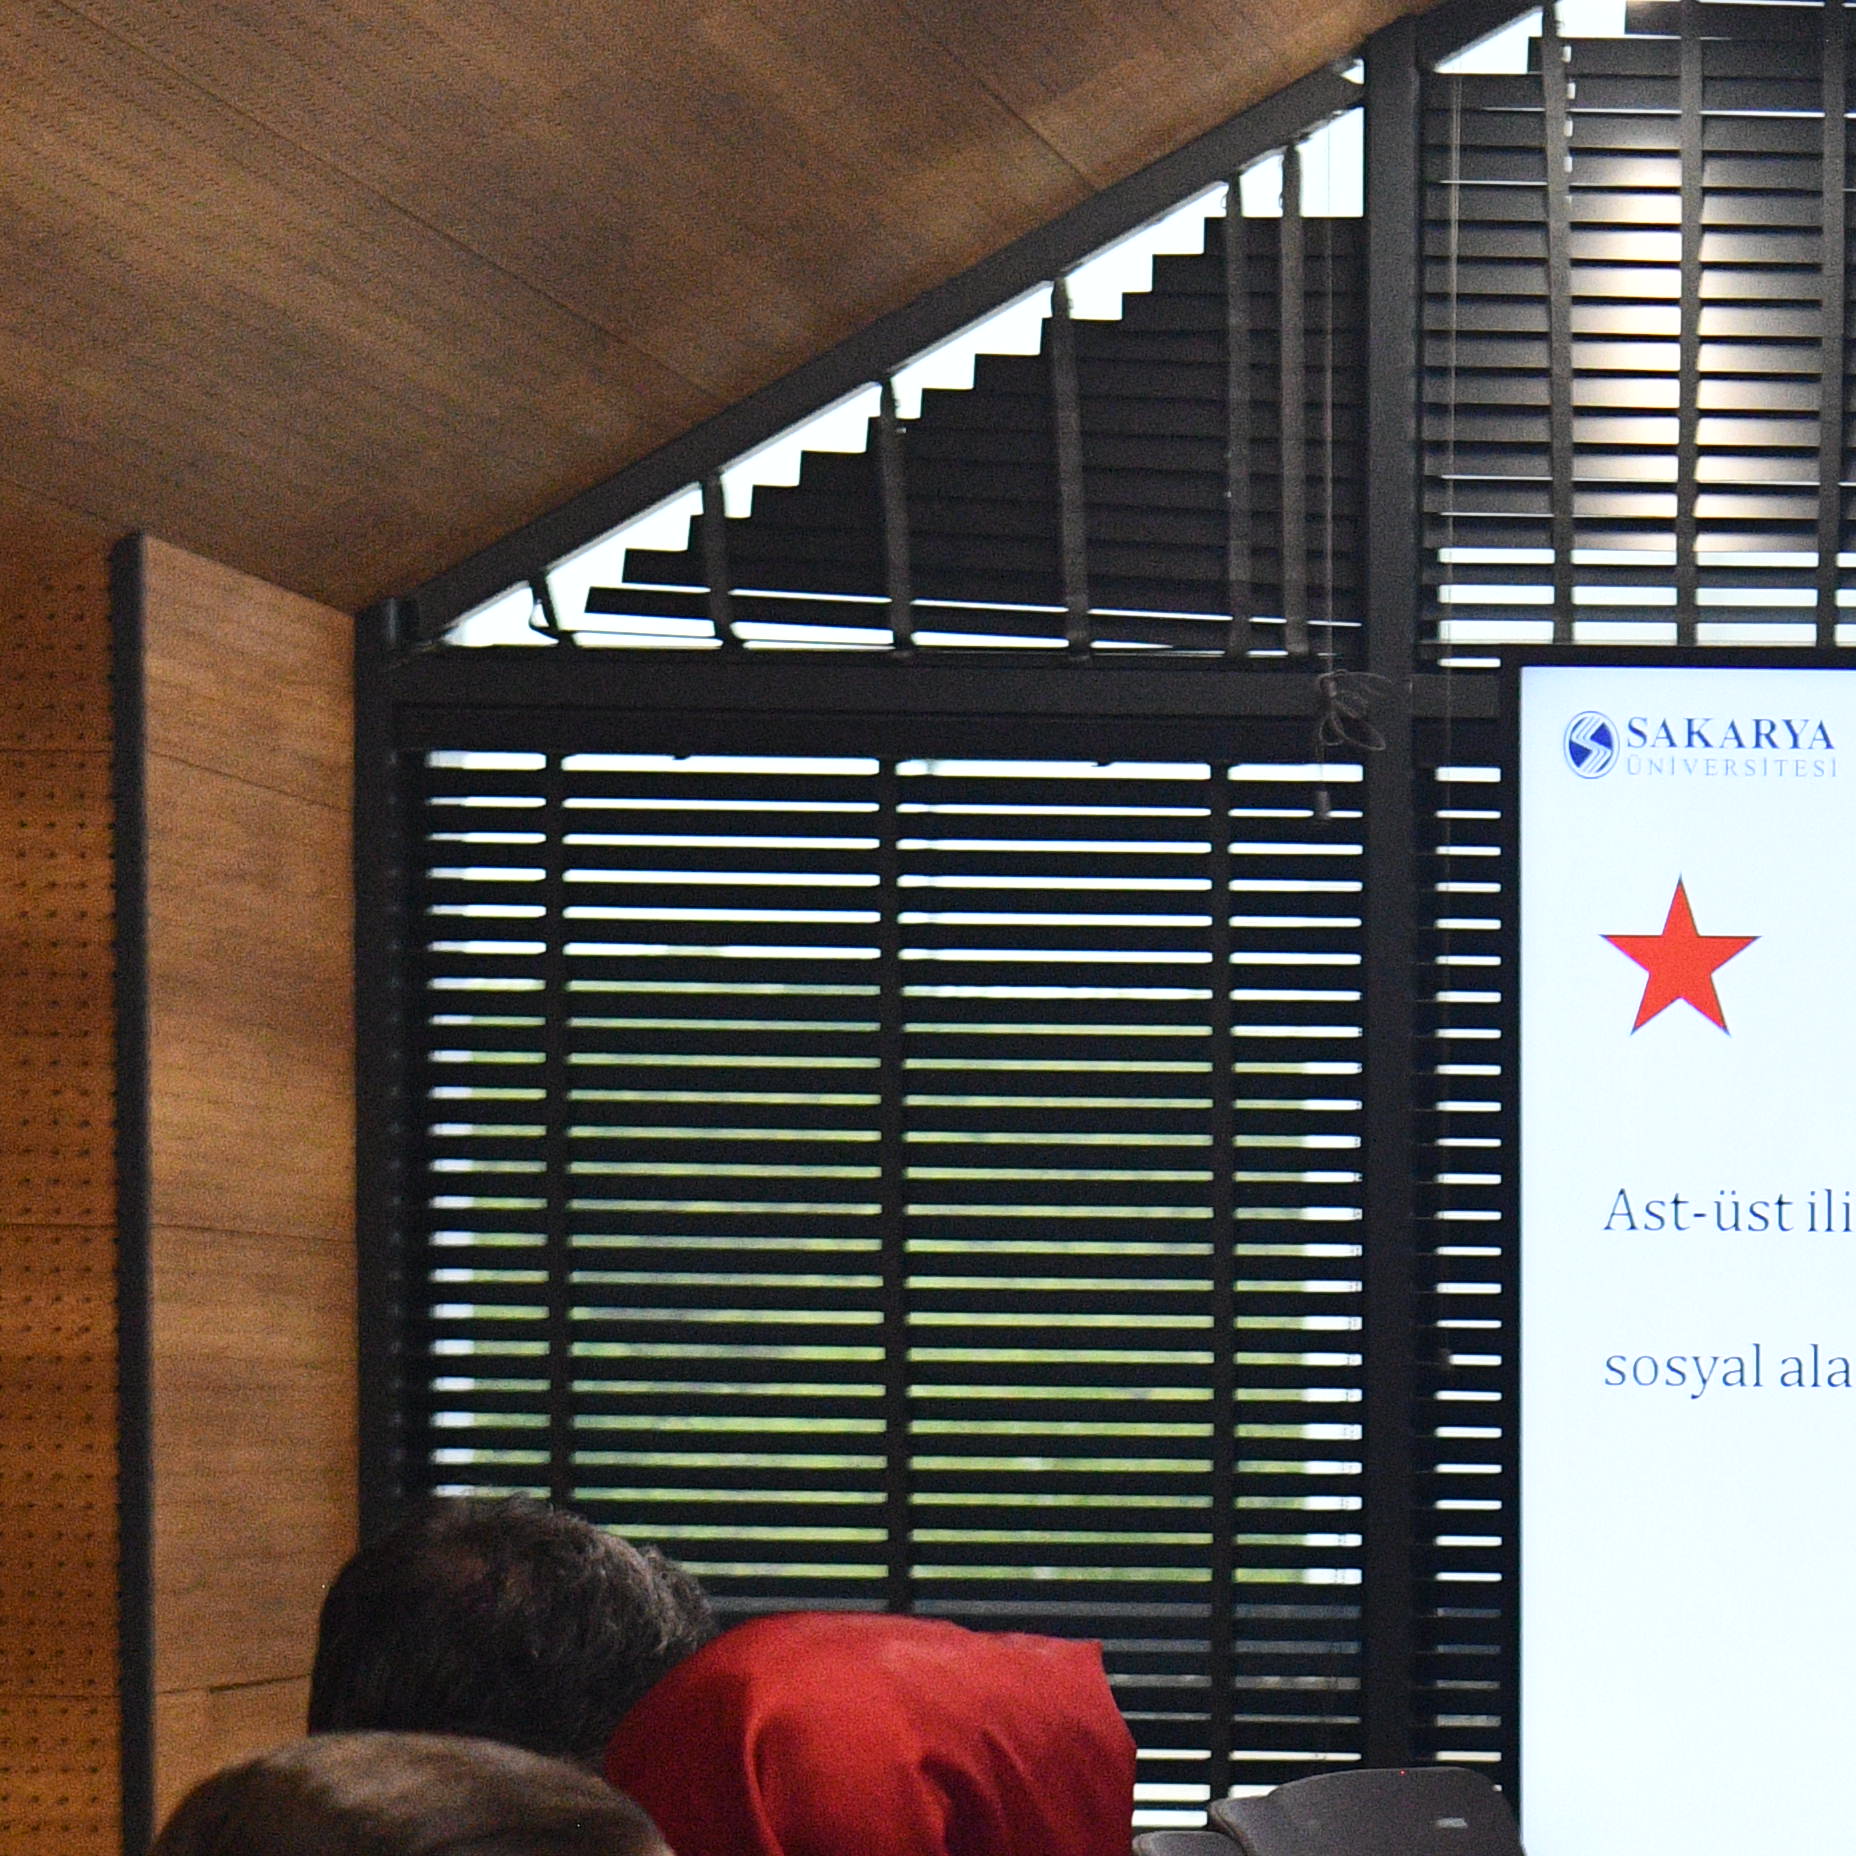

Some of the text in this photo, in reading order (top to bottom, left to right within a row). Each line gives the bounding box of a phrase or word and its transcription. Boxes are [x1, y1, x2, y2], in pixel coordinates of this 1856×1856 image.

[1625, 715, 1836, 751] SAKARYA
[1625, 755, 1838, 779] ÜNİVERSİTESİ
[1602, 1186, 1794, 1234] Ast-üst
[1603, 1341, 1764, 1402] sosyal
